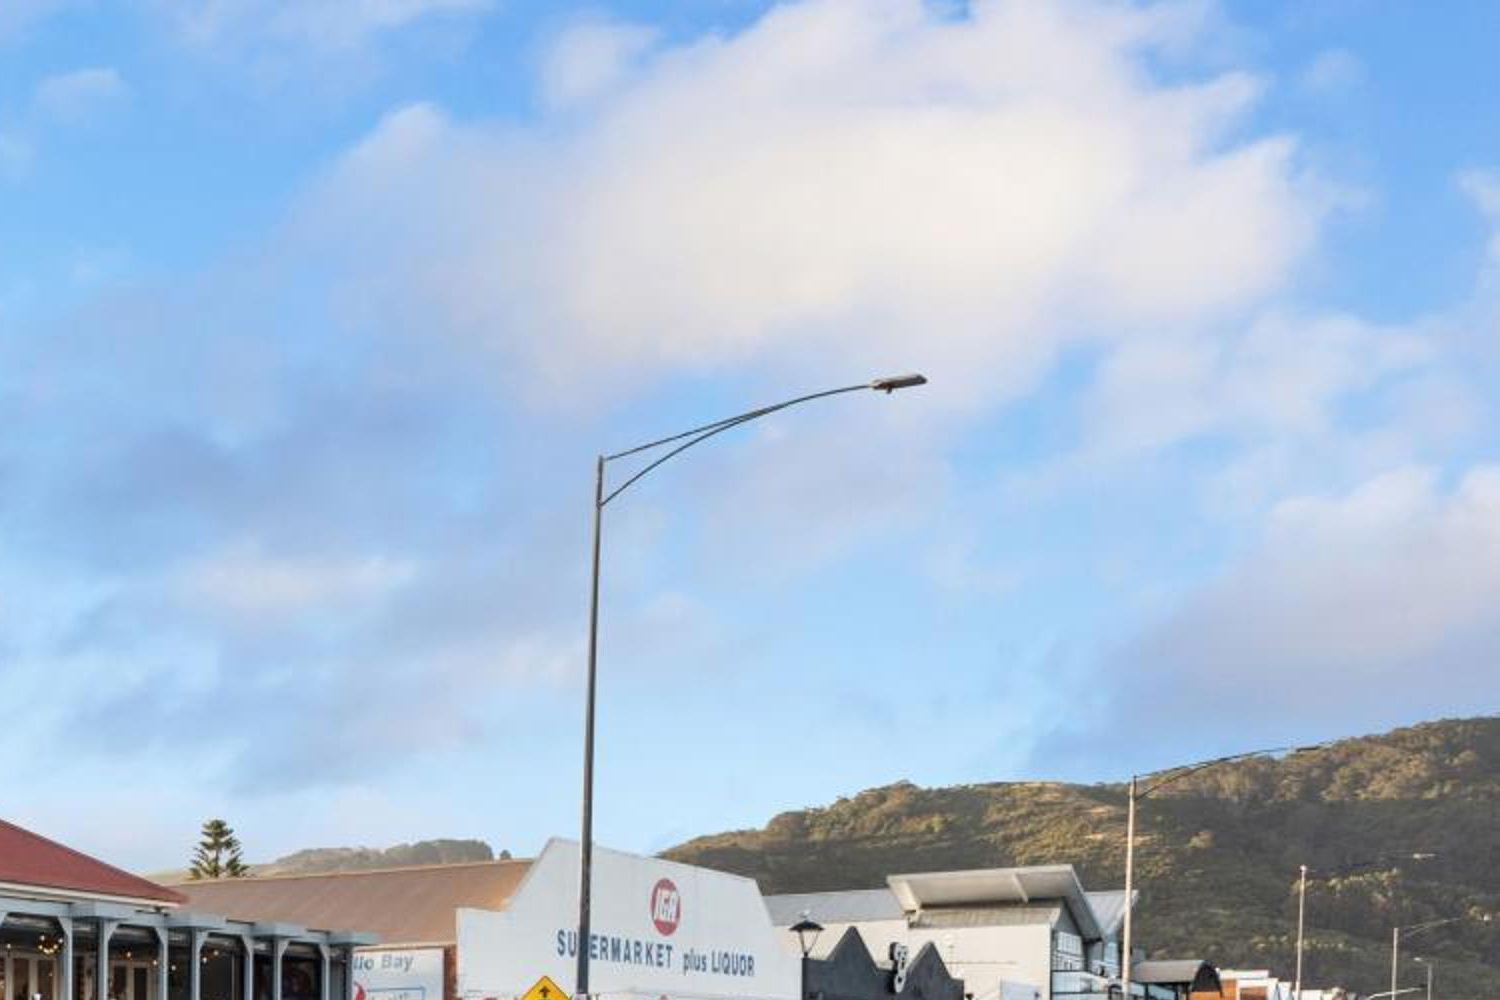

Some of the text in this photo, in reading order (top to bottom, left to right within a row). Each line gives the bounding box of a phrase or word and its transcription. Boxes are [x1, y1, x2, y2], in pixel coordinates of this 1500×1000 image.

[655, 888, 677, 922] IGA
[381, 954, 413, 972] Bay
[557, 929, 755, 976] SUERMARKET plus LIQUOR
